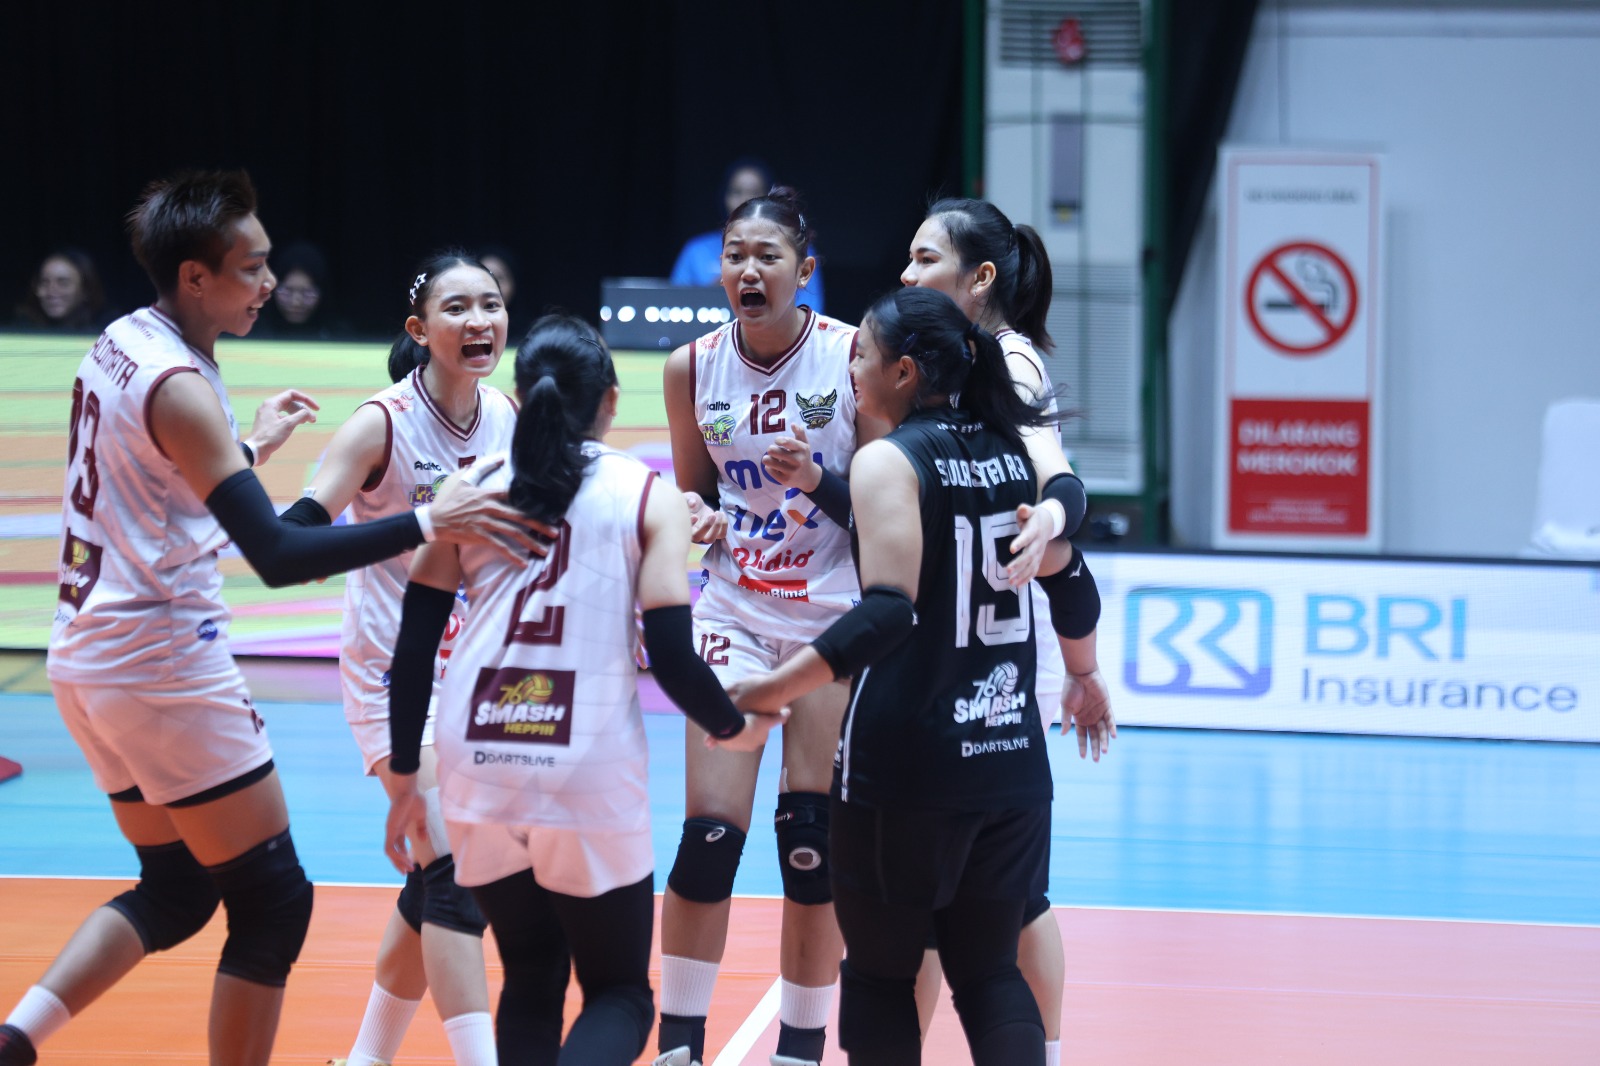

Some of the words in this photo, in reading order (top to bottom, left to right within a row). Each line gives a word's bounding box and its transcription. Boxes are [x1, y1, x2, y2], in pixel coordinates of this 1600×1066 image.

[749, 389, 787, 436] 12
[1238, 419, 1360, 447] DILARANG
[1237, 448, 1359, 475] MEROKOK
[732, 548, 814, 571] Vidio
[954, 510, 1030, 648] 15
[1305, 593, 1468, 662] BRI
[700, 633, 731, 666] 12
[1302, 667, 1579, 713] Insurance
[474, 701, 567, 726] SMASH
[953, 691, 1026, 723] SMASH
